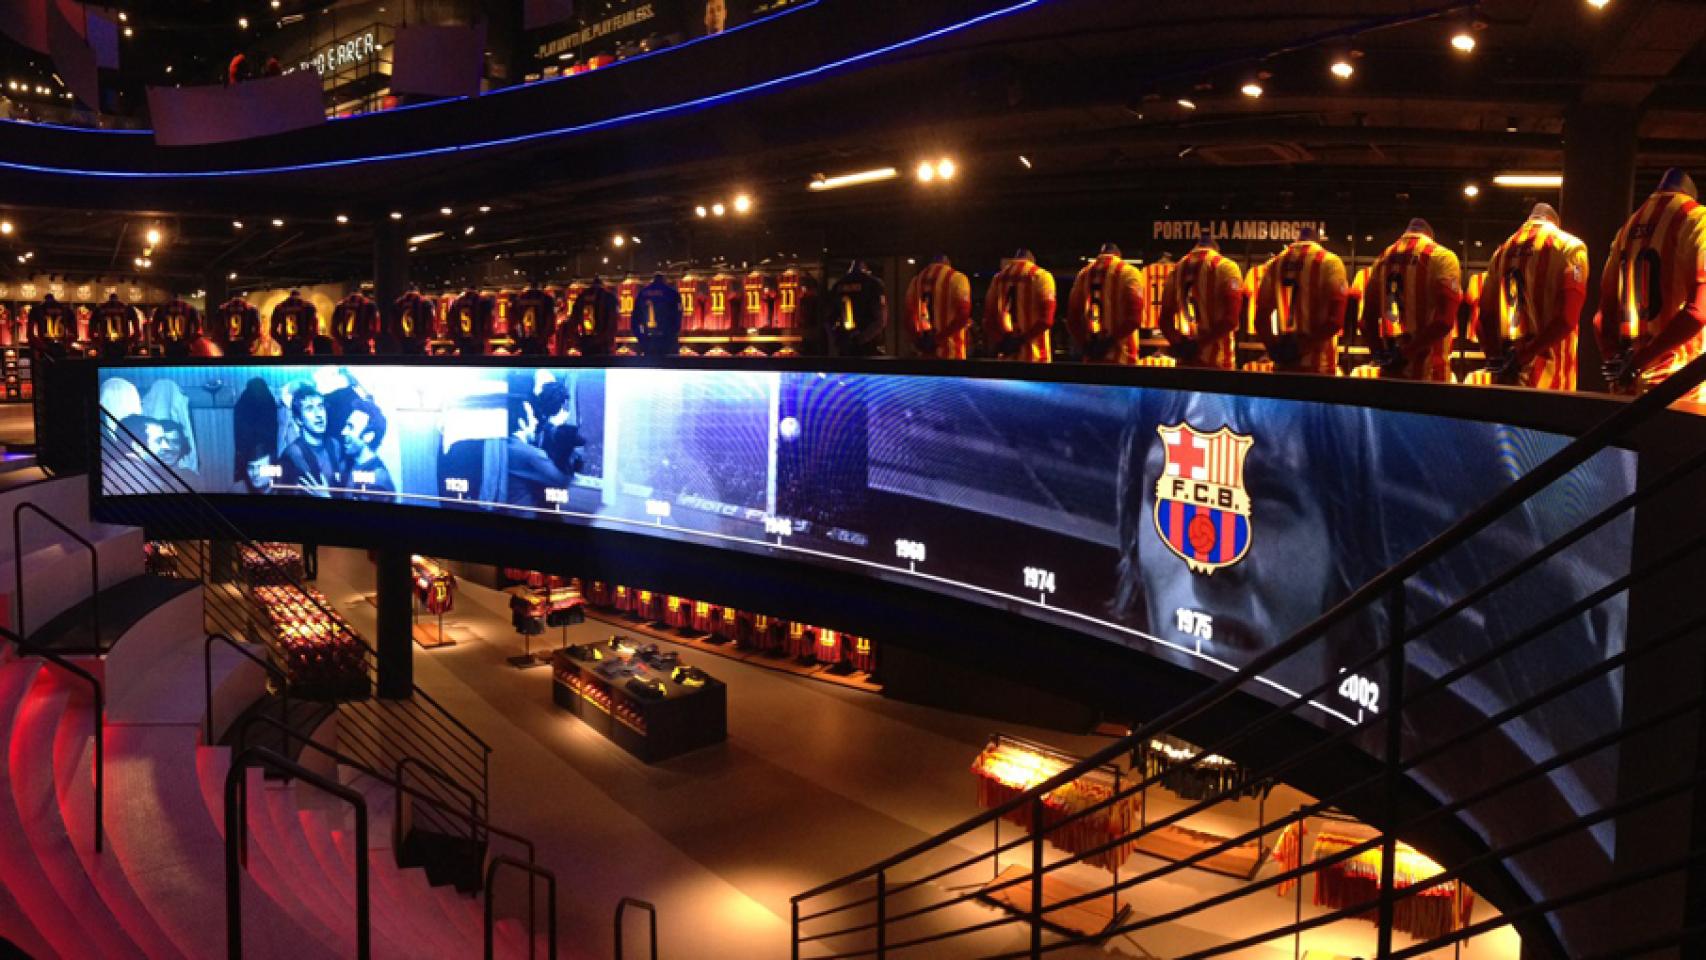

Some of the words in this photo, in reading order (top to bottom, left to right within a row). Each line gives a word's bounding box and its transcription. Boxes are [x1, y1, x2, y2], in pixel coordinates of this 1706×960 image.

[1172, 479, 1240, 510] F.C.B.
[1023, 566, 1056, 594] 1974
[1176, 607, 1213, 640] 1975
